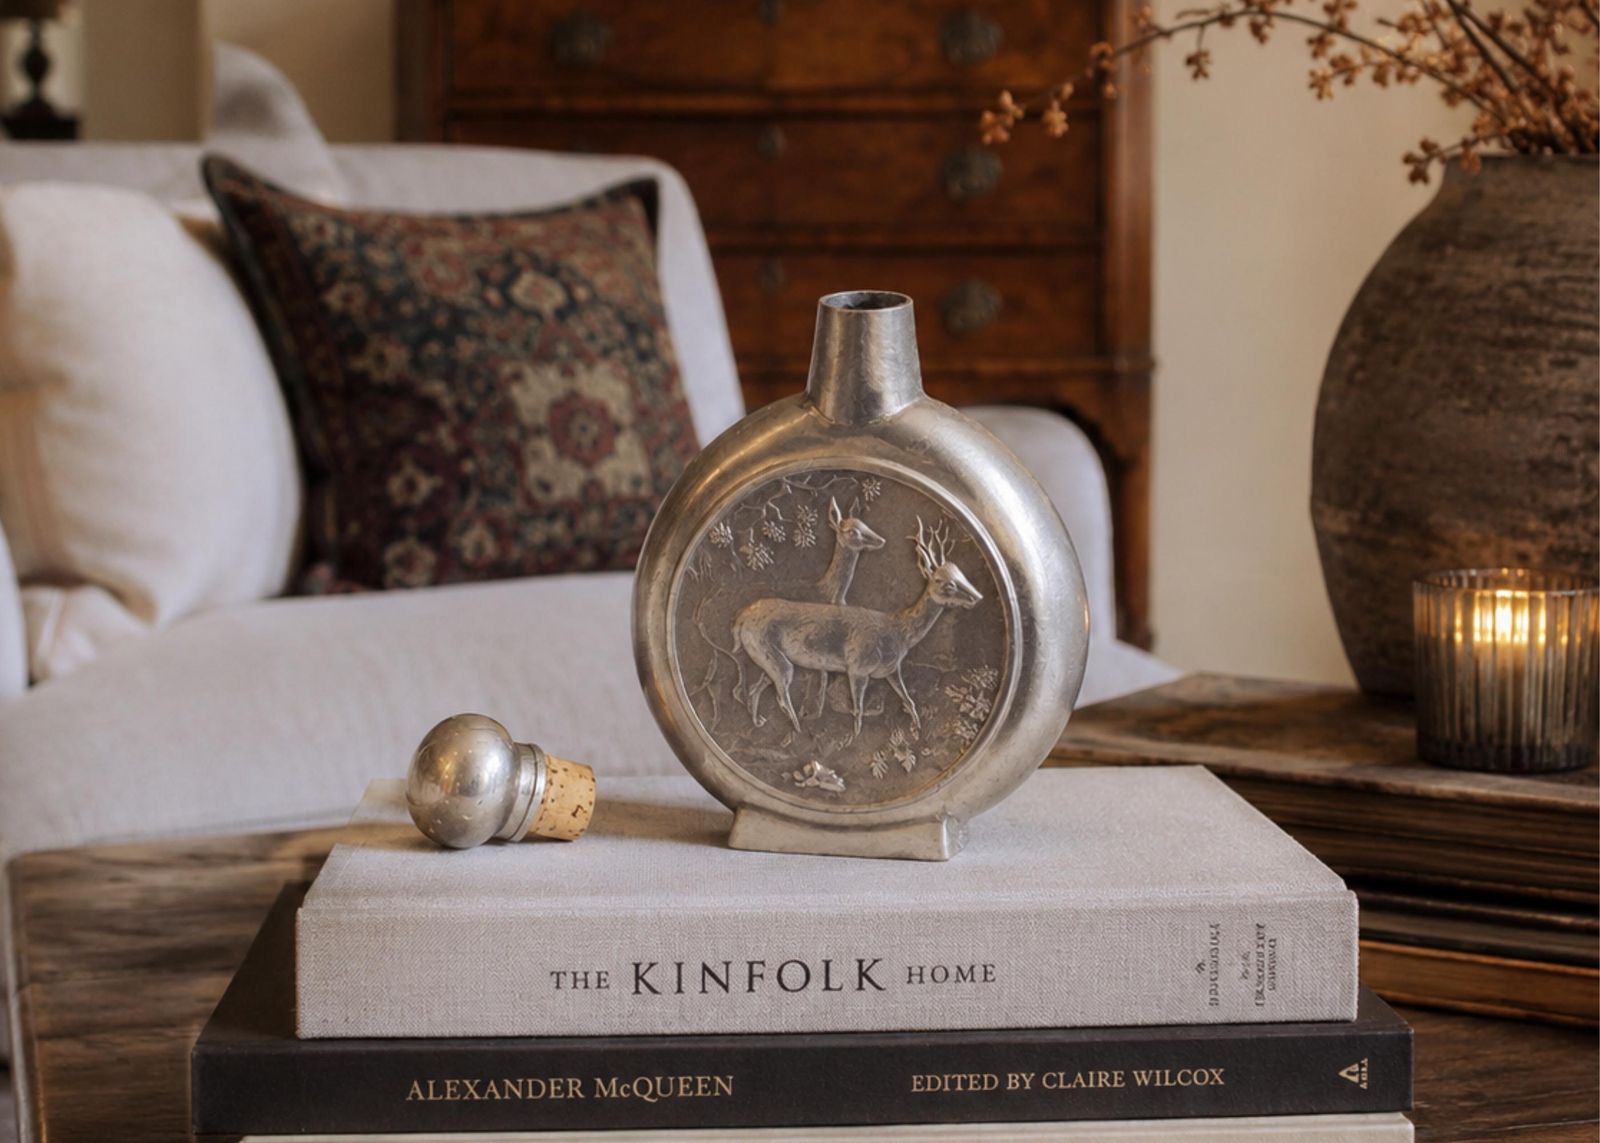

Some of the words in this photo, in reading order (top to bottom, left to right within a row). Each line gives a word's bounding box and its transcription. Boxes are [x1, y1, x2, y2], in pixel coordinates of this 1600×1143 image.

[550, 970, 611, 991] THE
[631, 958, 887, 996] KINFOLK
[905, 964, 997, 985] HOME
[405, 1077, 586, 1102] ALEXANDER
[593, 1075, 735, 1103] McQUEEN
[910, 1073, 999, 1093] EDITED
[1006, 1073, 1035, 1091] BY
[1041, 1070, 1126, 1091] CLAIRE
[1132, 1067, 1226, 1088] WILCOX
